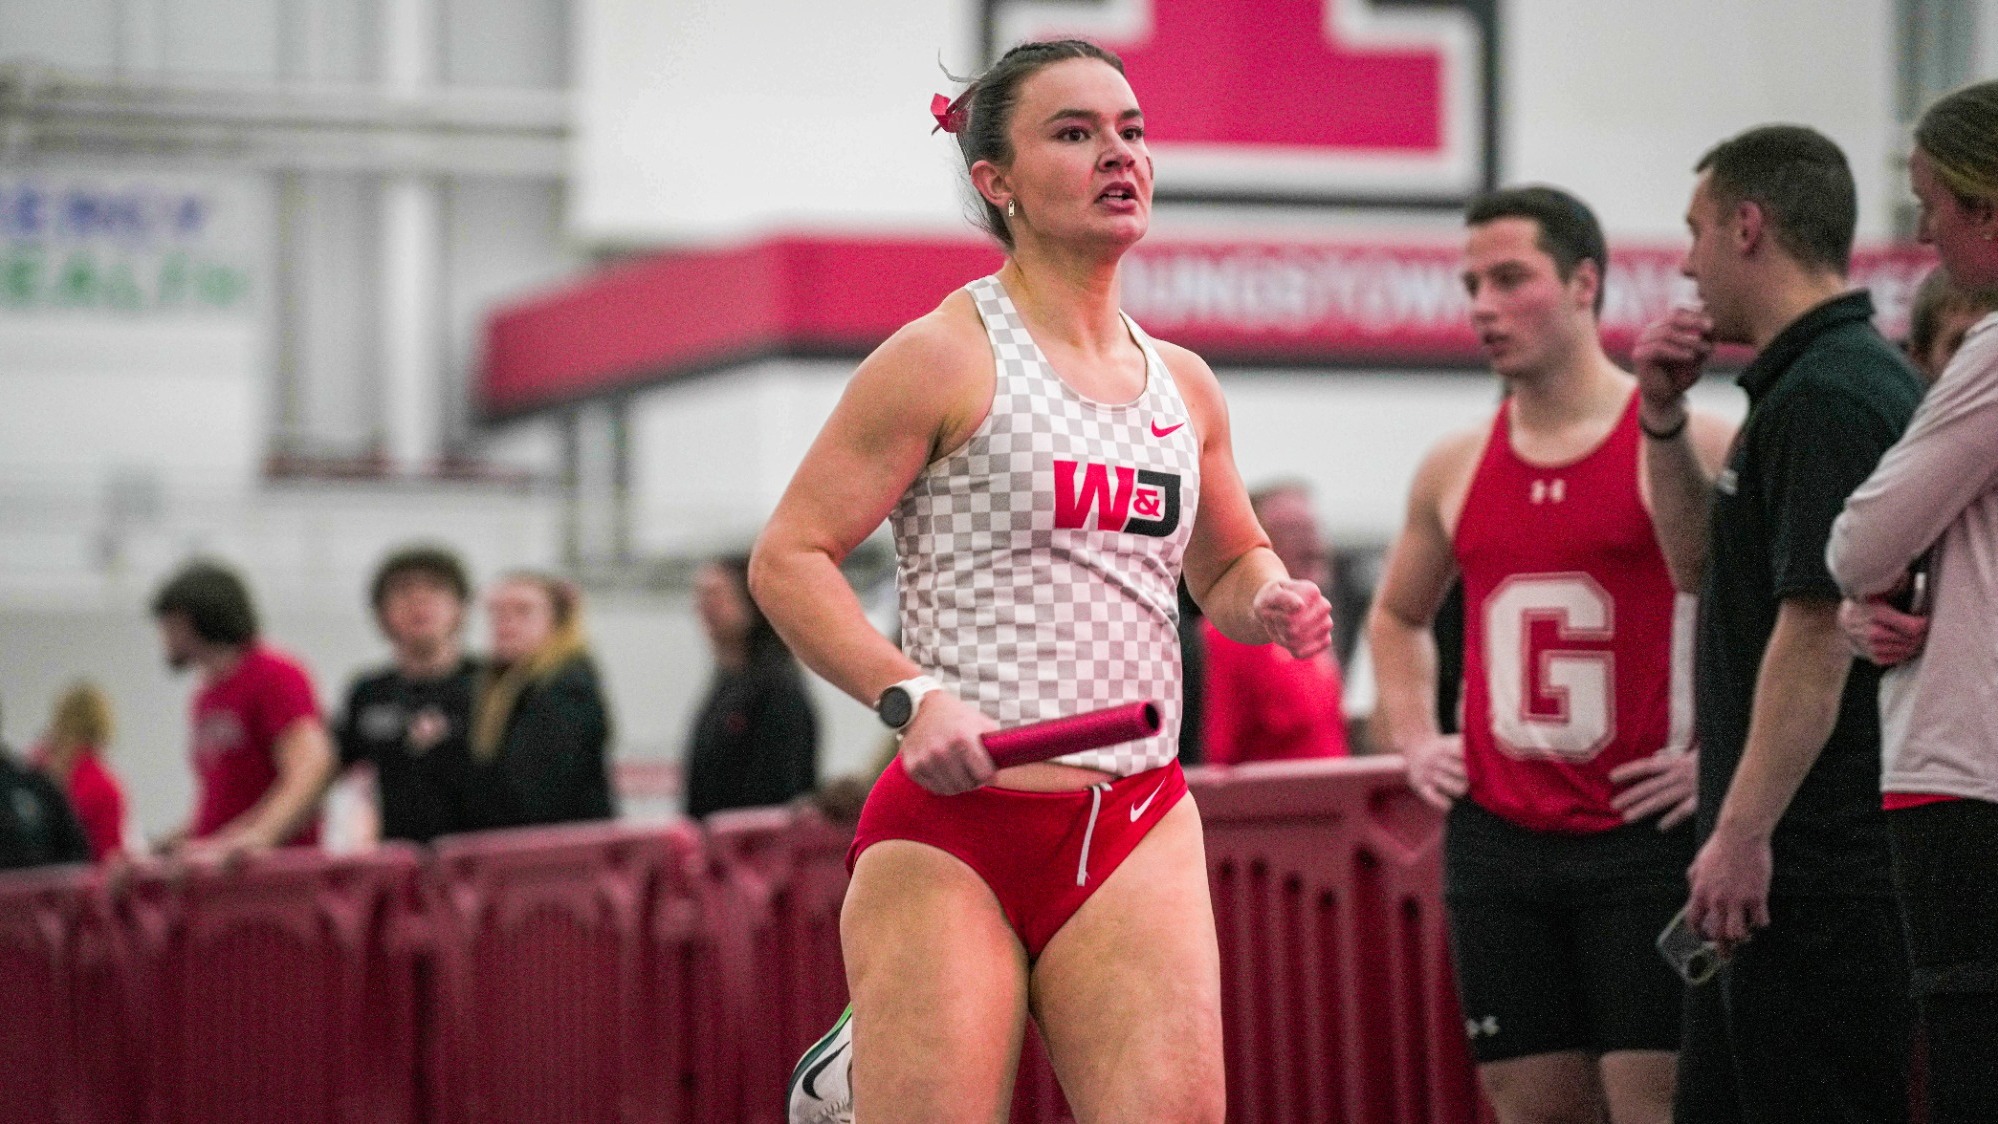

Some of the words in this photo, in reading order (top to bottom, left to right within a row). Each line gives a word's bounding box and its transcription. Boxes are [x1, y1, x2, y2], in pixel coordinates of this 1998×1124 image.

[0, 255, 249, 304] EALTH
[1053, 460, 1181, 538] W&J
[1482, 571, 1618, 764] G
